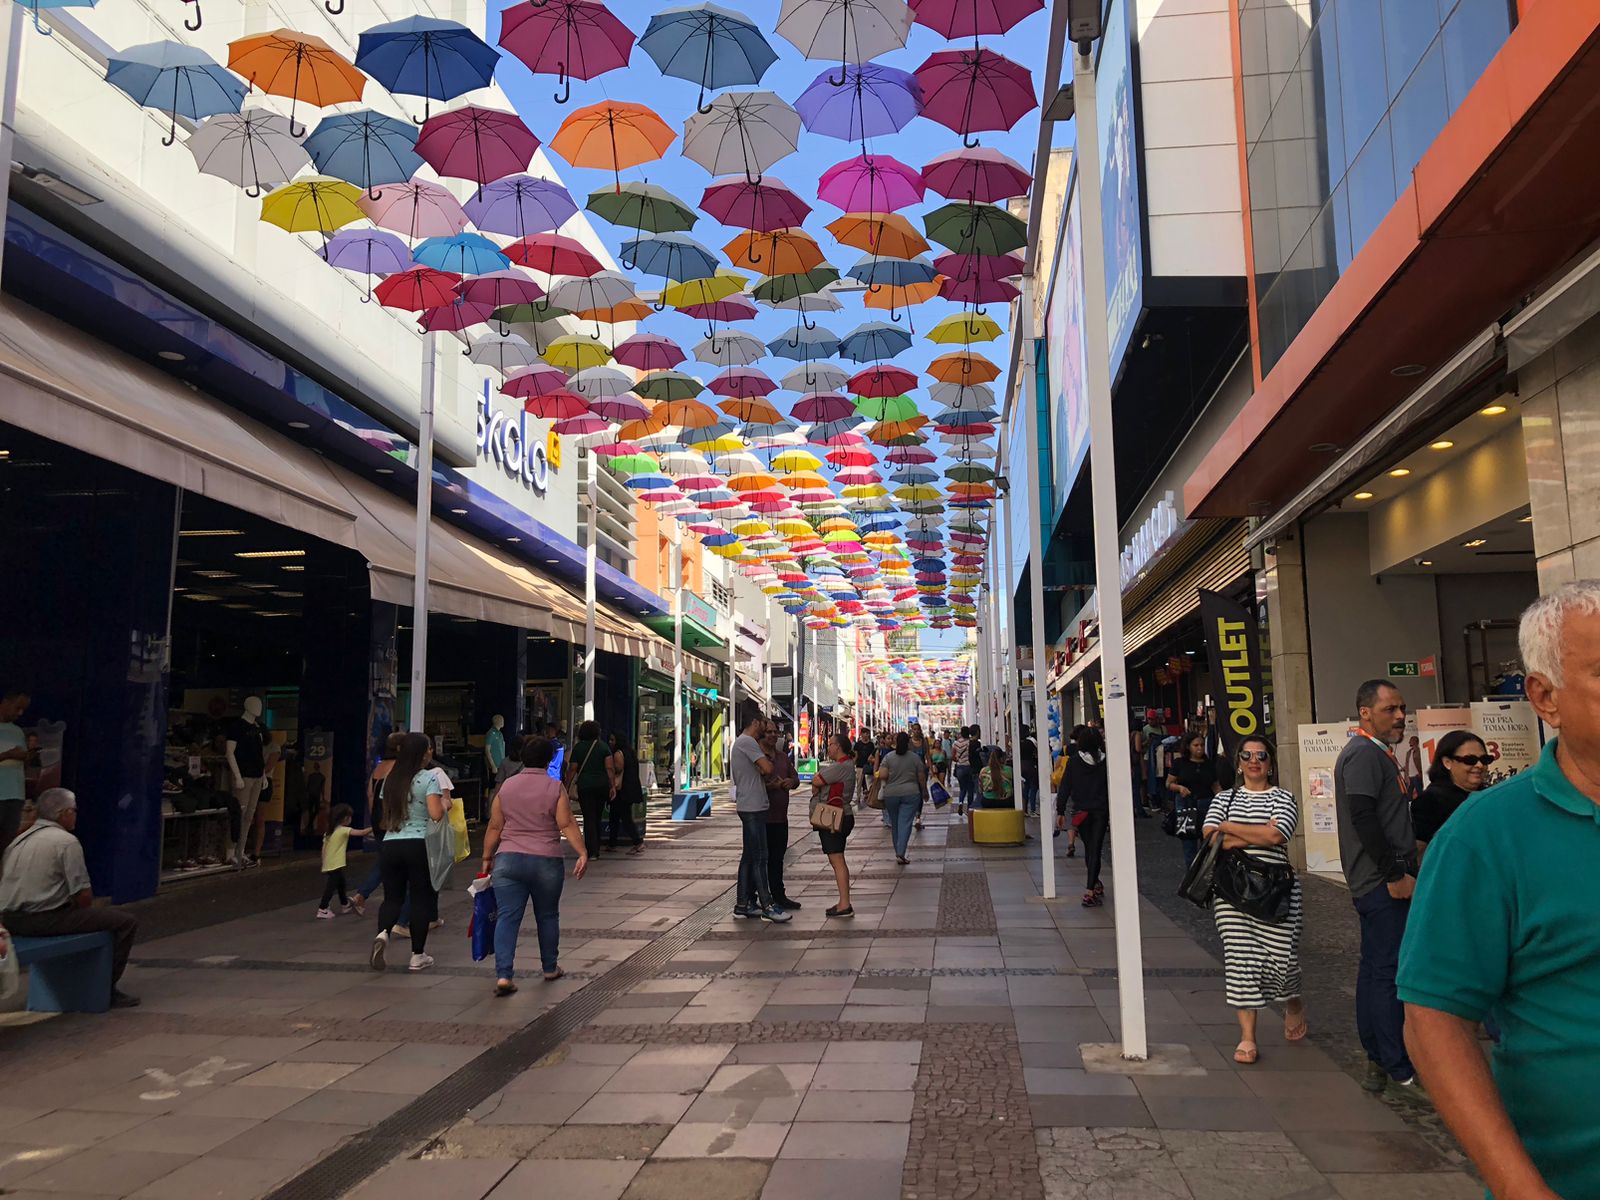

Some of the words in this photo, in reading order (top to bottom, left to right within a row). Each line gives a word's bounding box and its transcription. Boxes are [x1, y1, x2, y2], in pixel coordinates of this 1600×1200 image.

[1217, 617, 1257, 736] OUTLET
[310, 745, 326, 757] 29
[1486, 741, 1501, 761] 3
